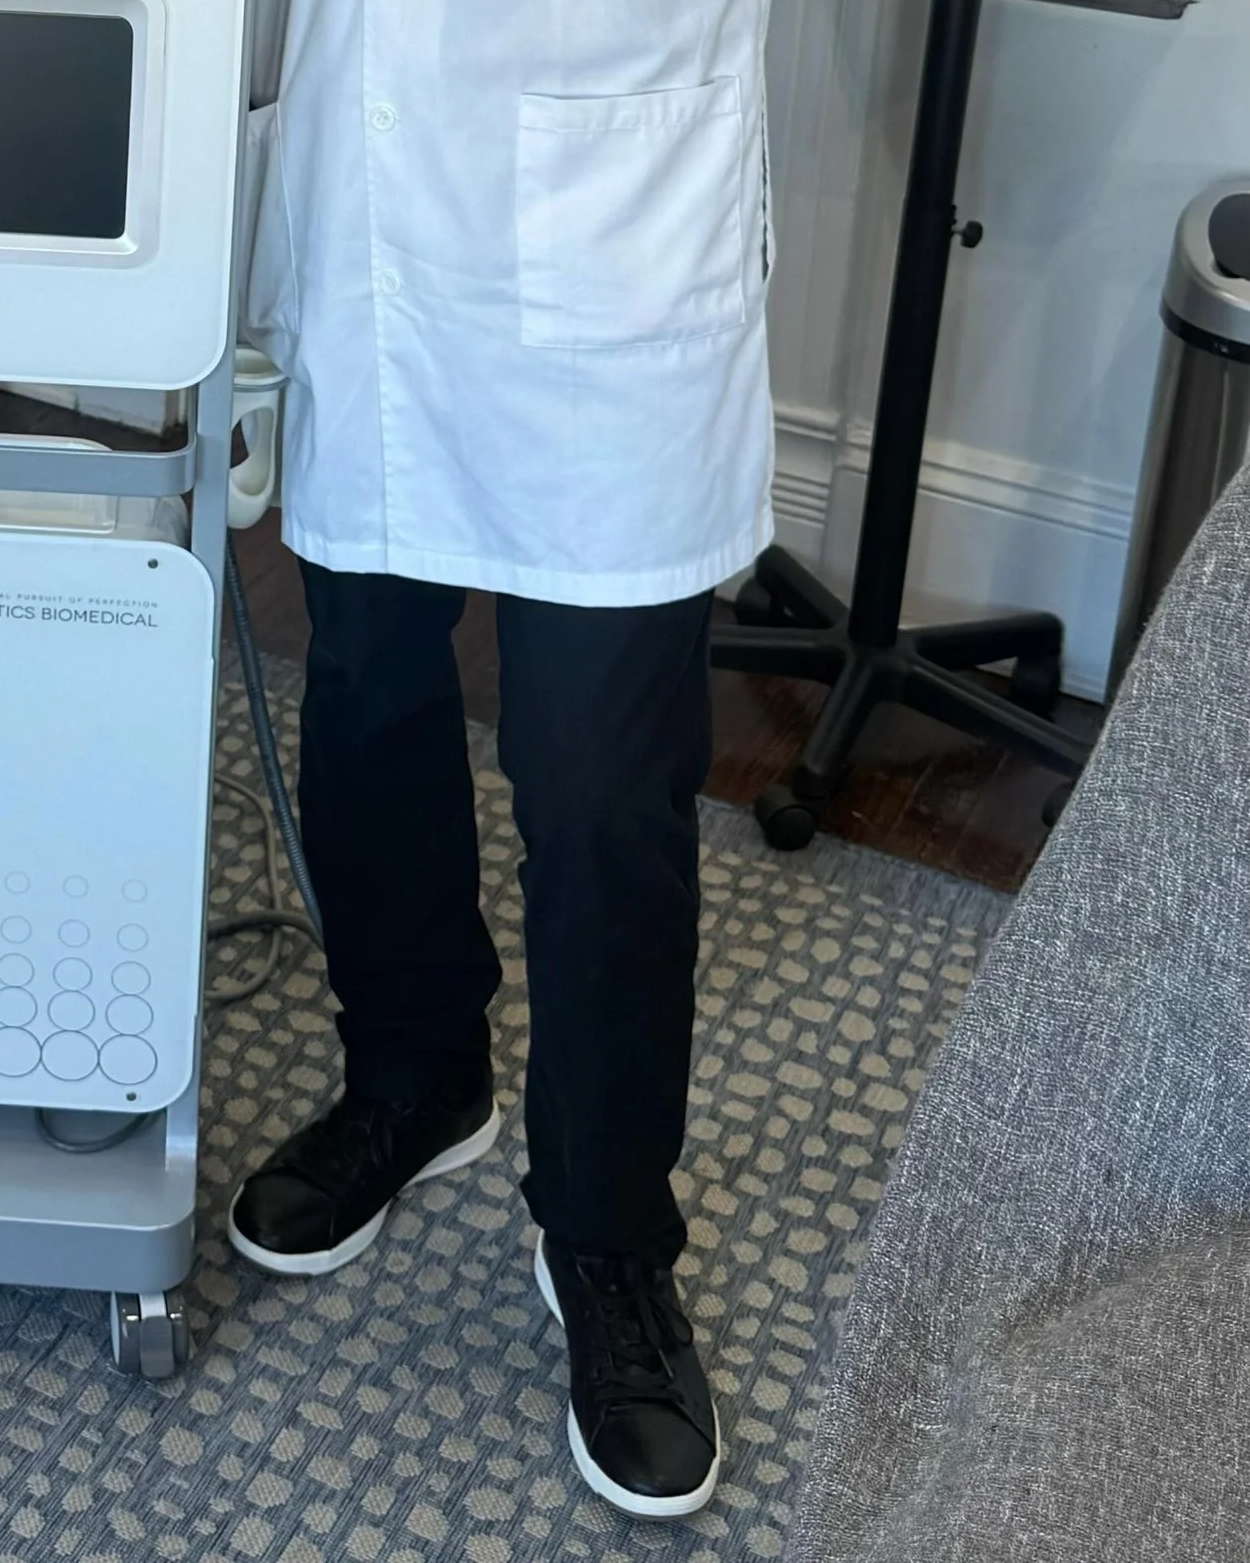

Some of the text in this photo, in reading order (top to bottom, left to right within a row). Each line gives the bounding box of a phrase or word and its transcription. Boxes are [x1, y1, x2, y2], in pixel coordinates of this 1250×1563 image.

[16, 593, 63, 603] PURSUIT
[68, 596, 82, 604] OF
[88, 597, 158, 609] PERFECTION
[41, 606, 158, 628] BIOMEDICAL
